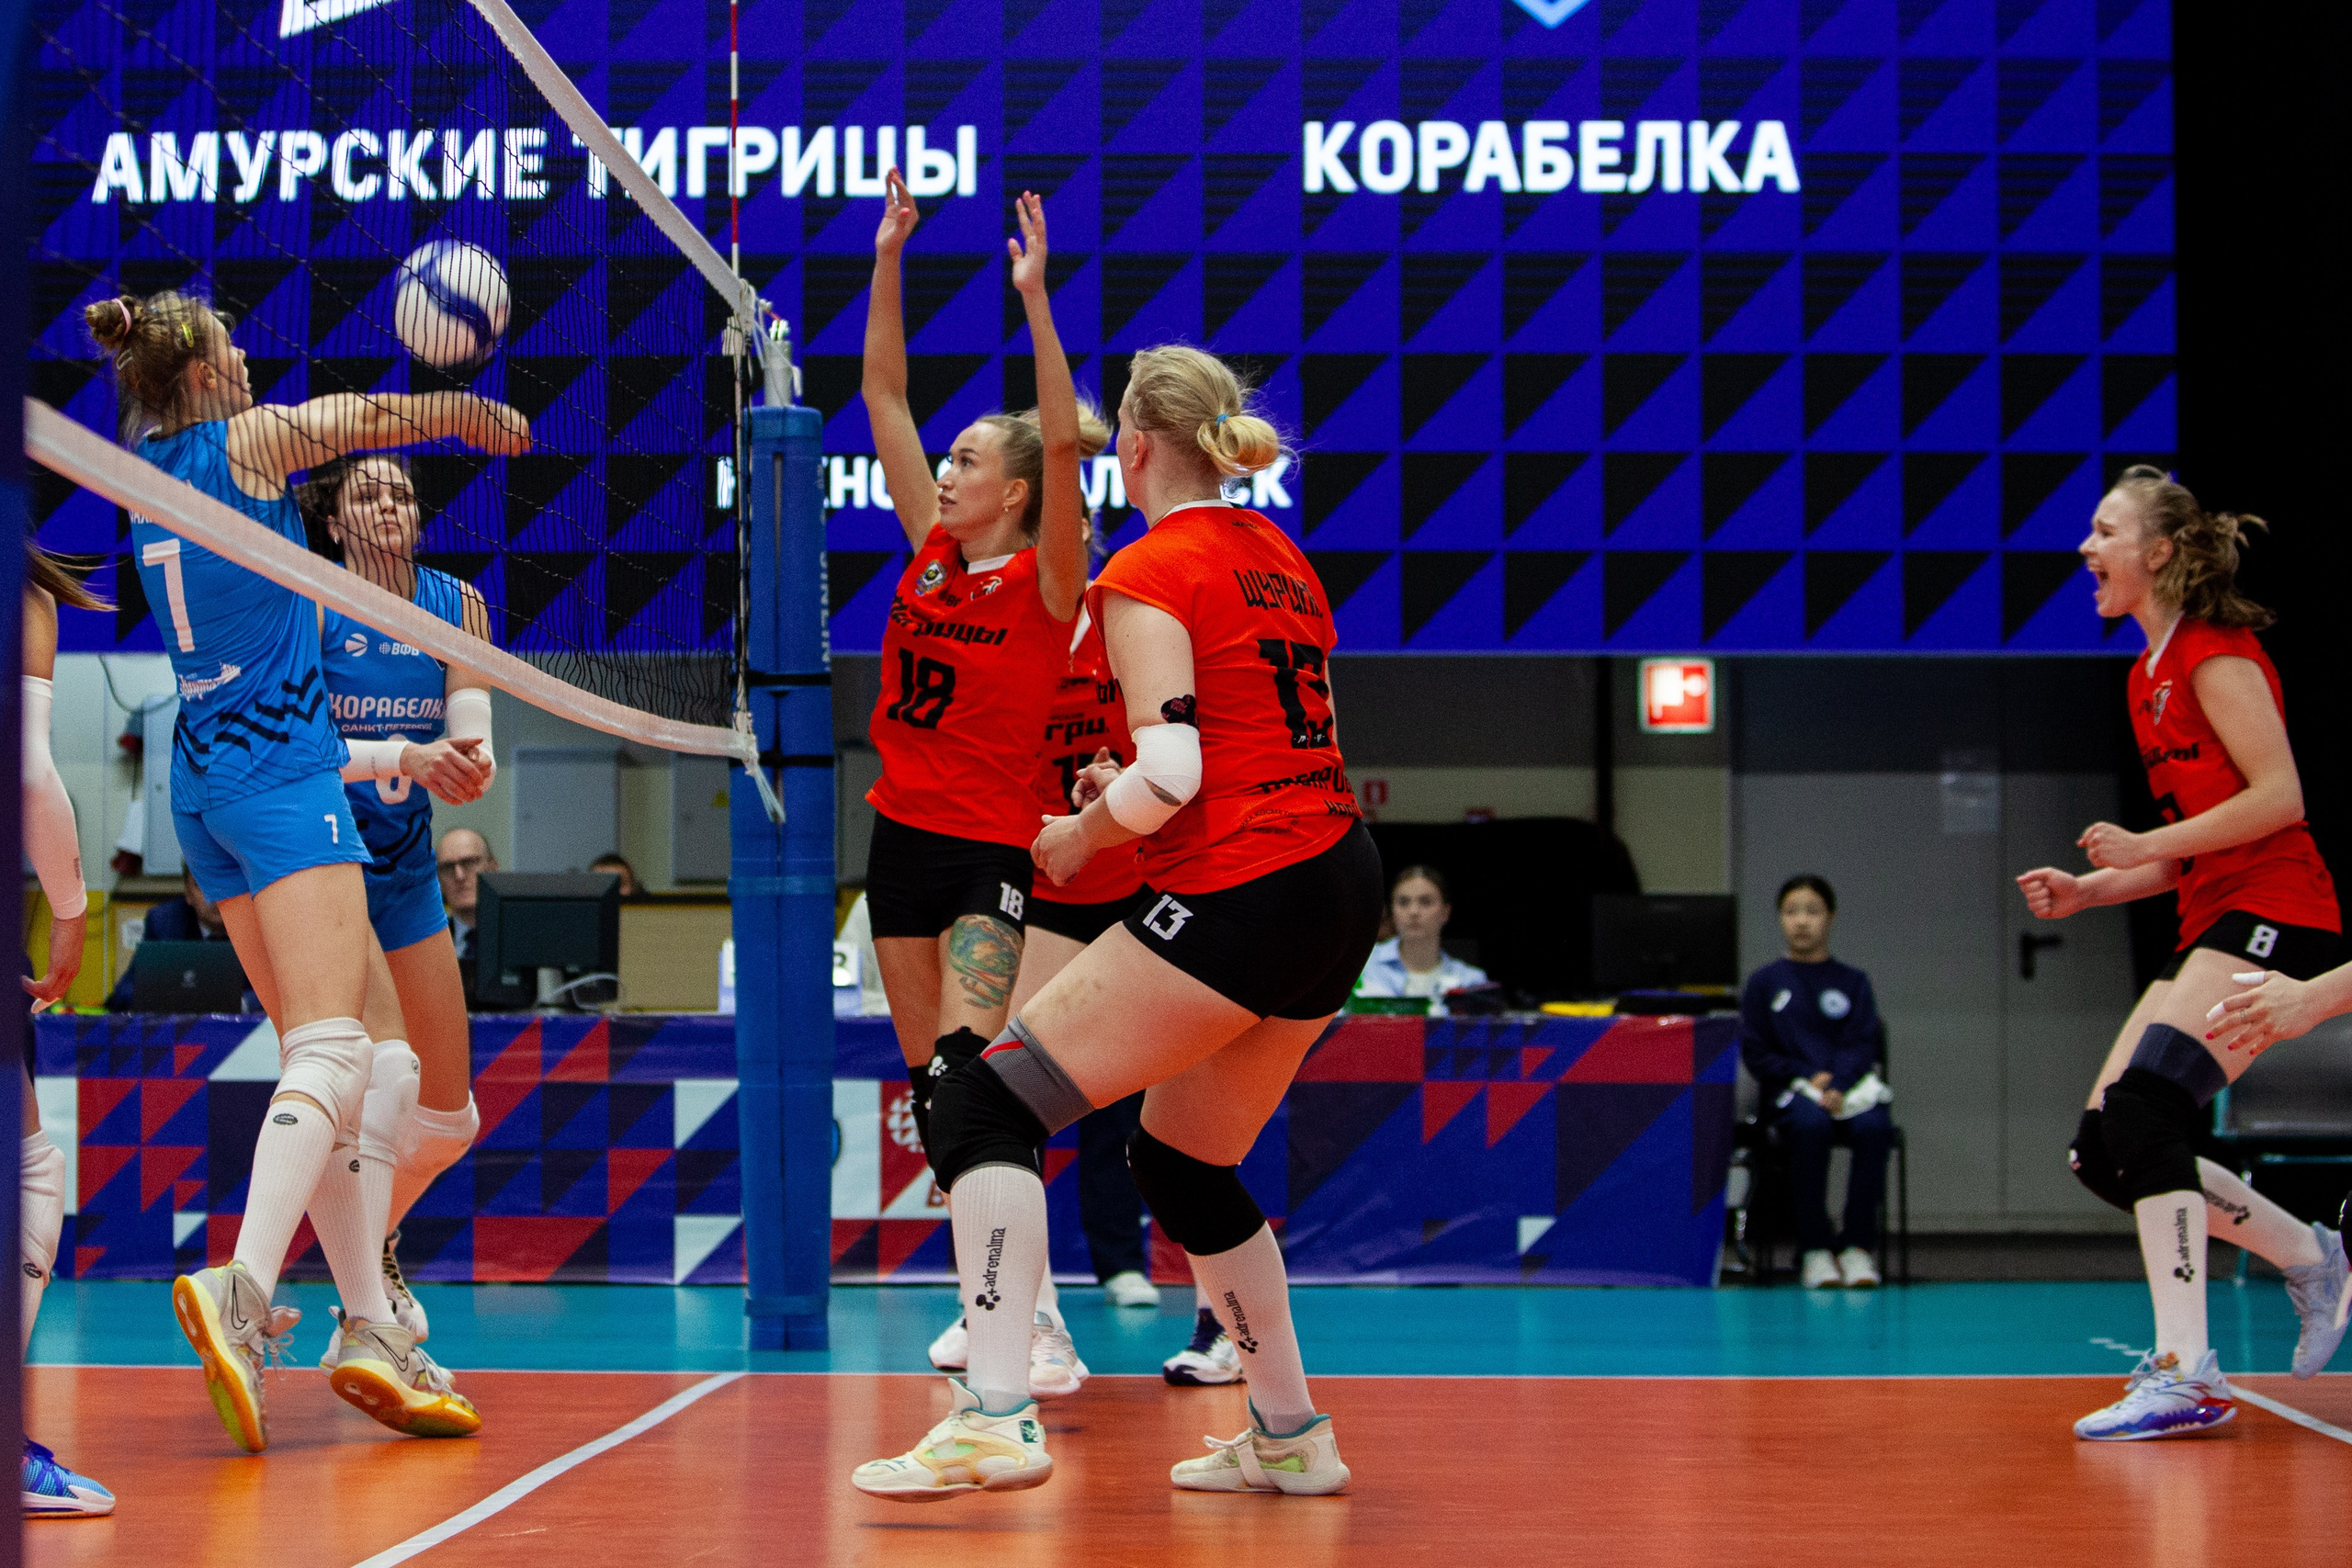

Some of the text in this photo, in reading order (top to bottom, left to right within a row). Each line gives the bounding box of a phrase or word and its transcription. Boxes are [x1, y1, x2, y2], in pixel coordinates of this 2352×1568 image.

[92, 125, 978, 204] АМУРСКИЕ ТИГРИЦЫ
[1303, 119, 1801, 193] КОРАБЕЛКА
[142, 538, 195, 652] 7
[329, 693, 446, 719] КОРАБЕЛК
[887, 647, 956, 729] 18
[324, 814, 338, 844] 7
[999, 882, 1024, 920] 18
[1142, 894, 1193, 941] 13
[2245, 924, 2278, 958] 8
